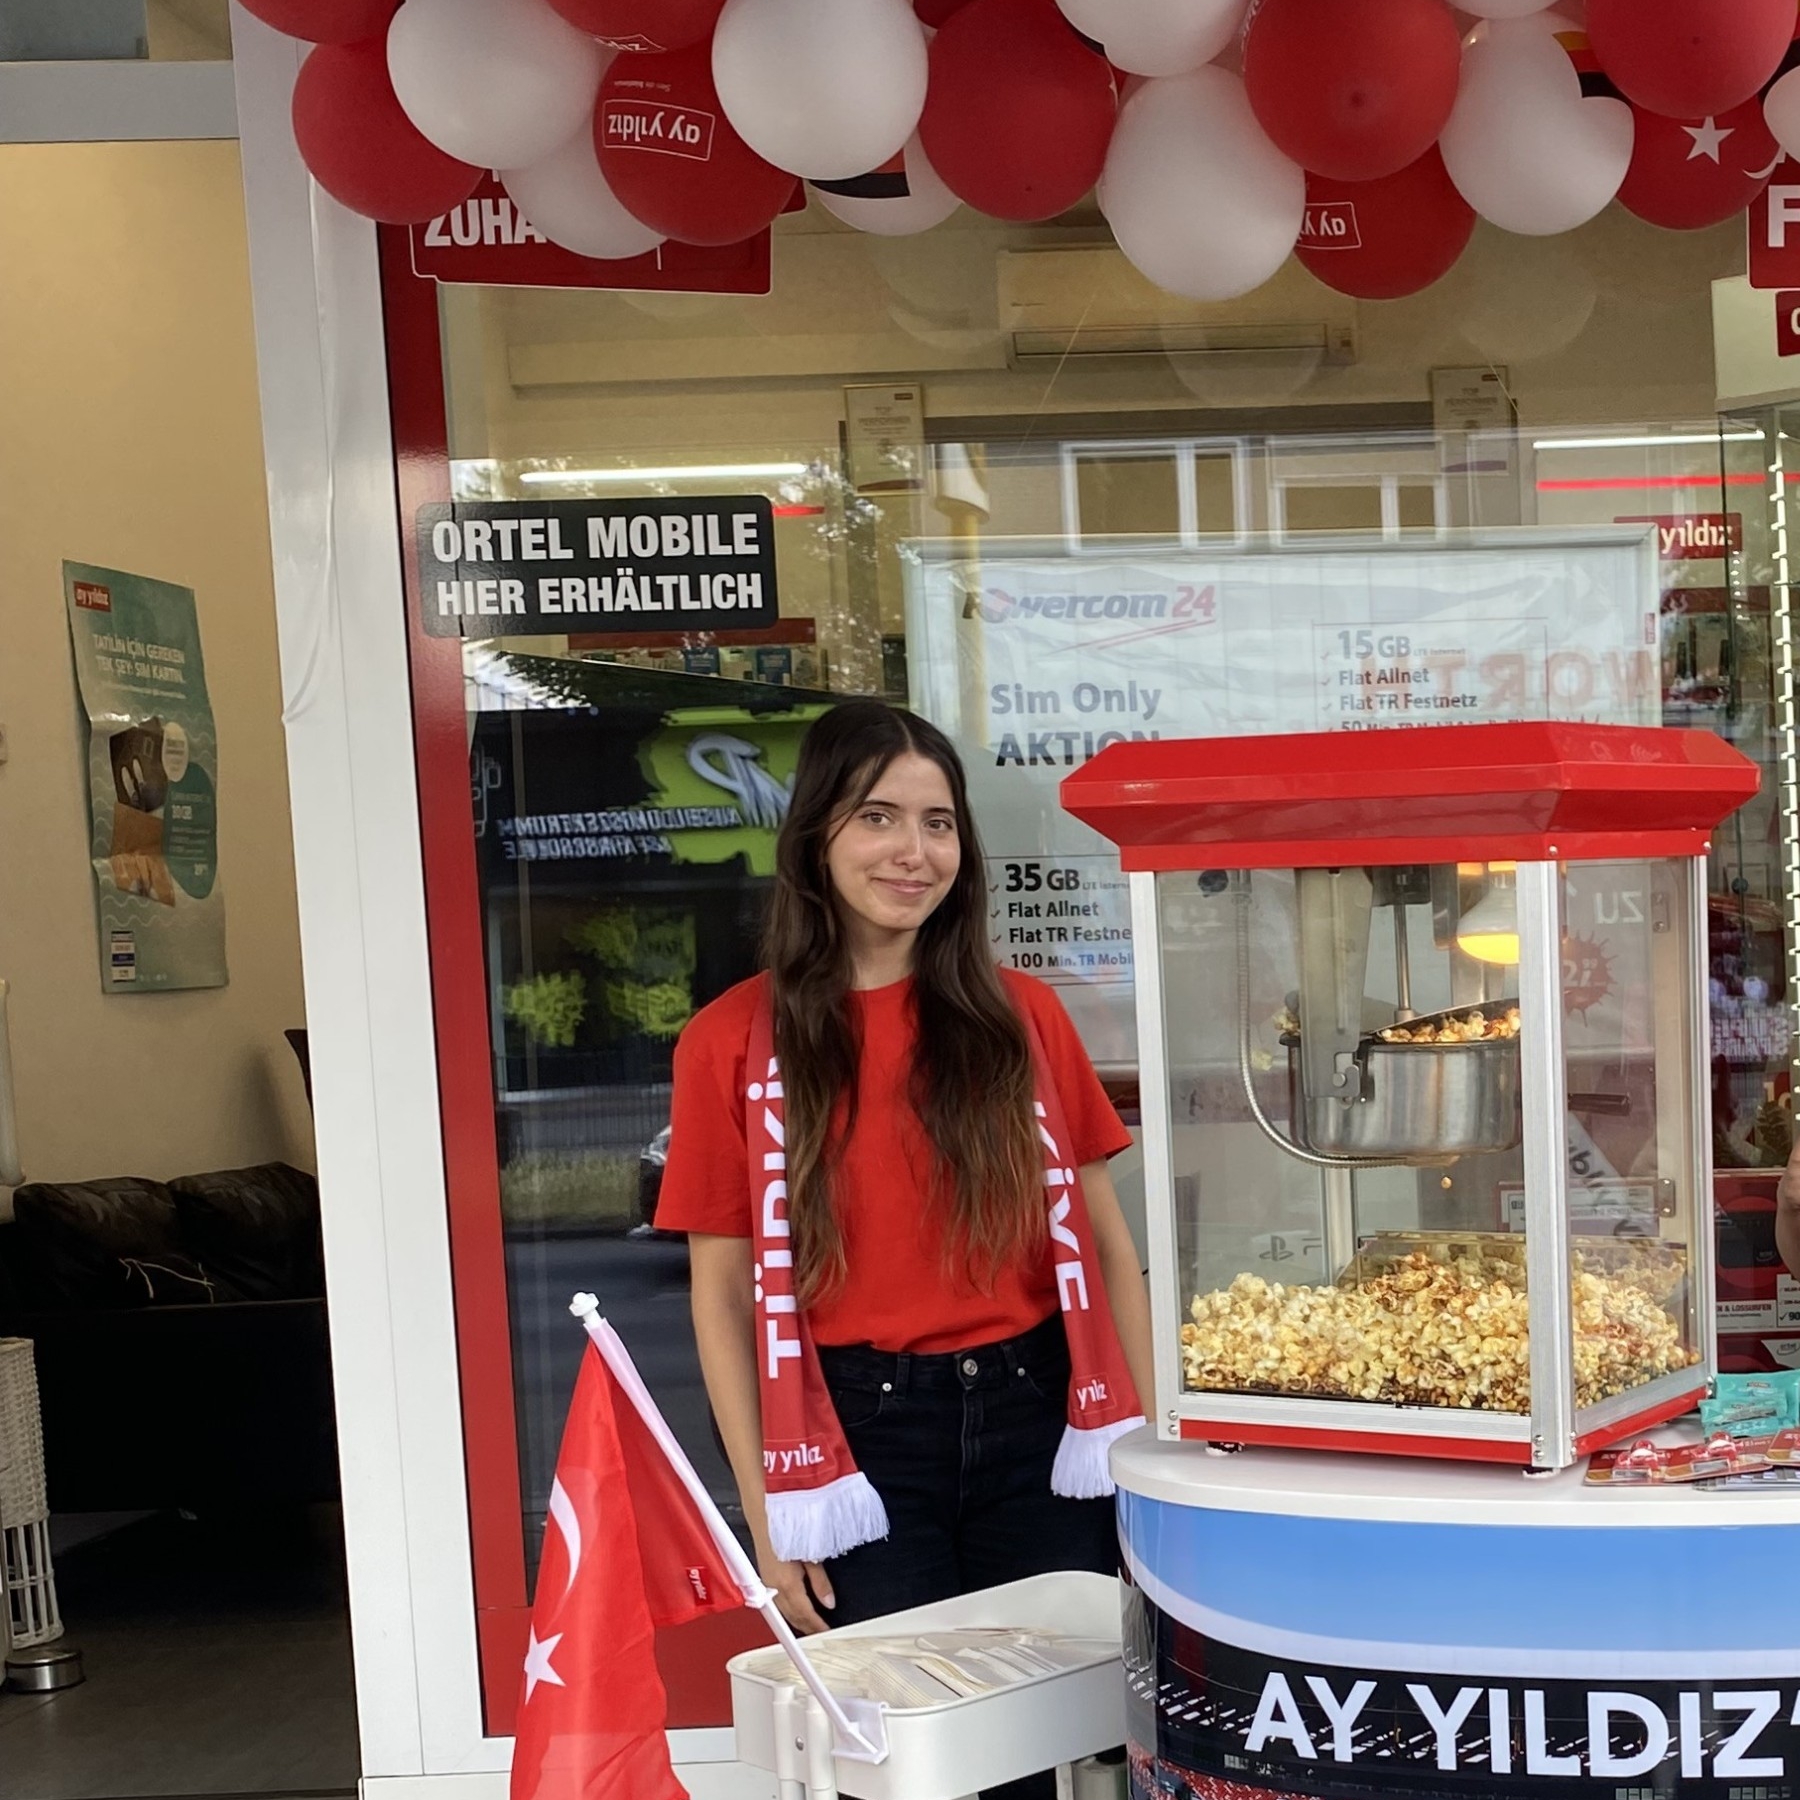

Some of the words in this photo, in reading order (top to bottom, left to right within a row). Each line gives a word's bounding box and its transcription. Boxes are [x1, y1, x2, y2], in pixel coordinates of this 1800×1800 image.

[668, 115, 701, 146] ay
[424, 198, 548, 247] ZUHA
[432, 516, 574, 564] ORTEL
[588, 512, 760, 559] MOBILE
[437, 579, 526, 617] HIER
[538, 566, 764, 615] ERHÄLTLICH
[1337, 629, 1374, 660] 15
[1378, 635, 1412, 658] GB
[1338, 668, 1372, 686] Flat
[1376, 667, 1430, 685] Allnet
[991, 683, 1061, 715] Sim
[1072, 680, 1162, 720] Only
[1340, 692, 1373, 711] Flat
[1374, 692, 1400, 709] TR
[1403, 691, 1478, 709] Festnetz
[1004, 863, 1042, 892] 35
[1046, 868, 1080, 891] GB
[1008, 902, 1041, 918] Flat
[1046, 900, 1100, 917] Allnet
[1009, 927, 1042, 944] Flat
[1045, 927, 1068, 942] TR
[1073, 925, 1132, 942] Festne
[1011, 953, 1042, 968] 100
[1047, 954, 1077, 967] Min.
[1078, 953, 1095, 966] TR
[1097, 952, 1133, 965] Mobi
[747, 1058, 802, 1380] TÜRKİ
[1243, 1671, 1378, 1763] AY
